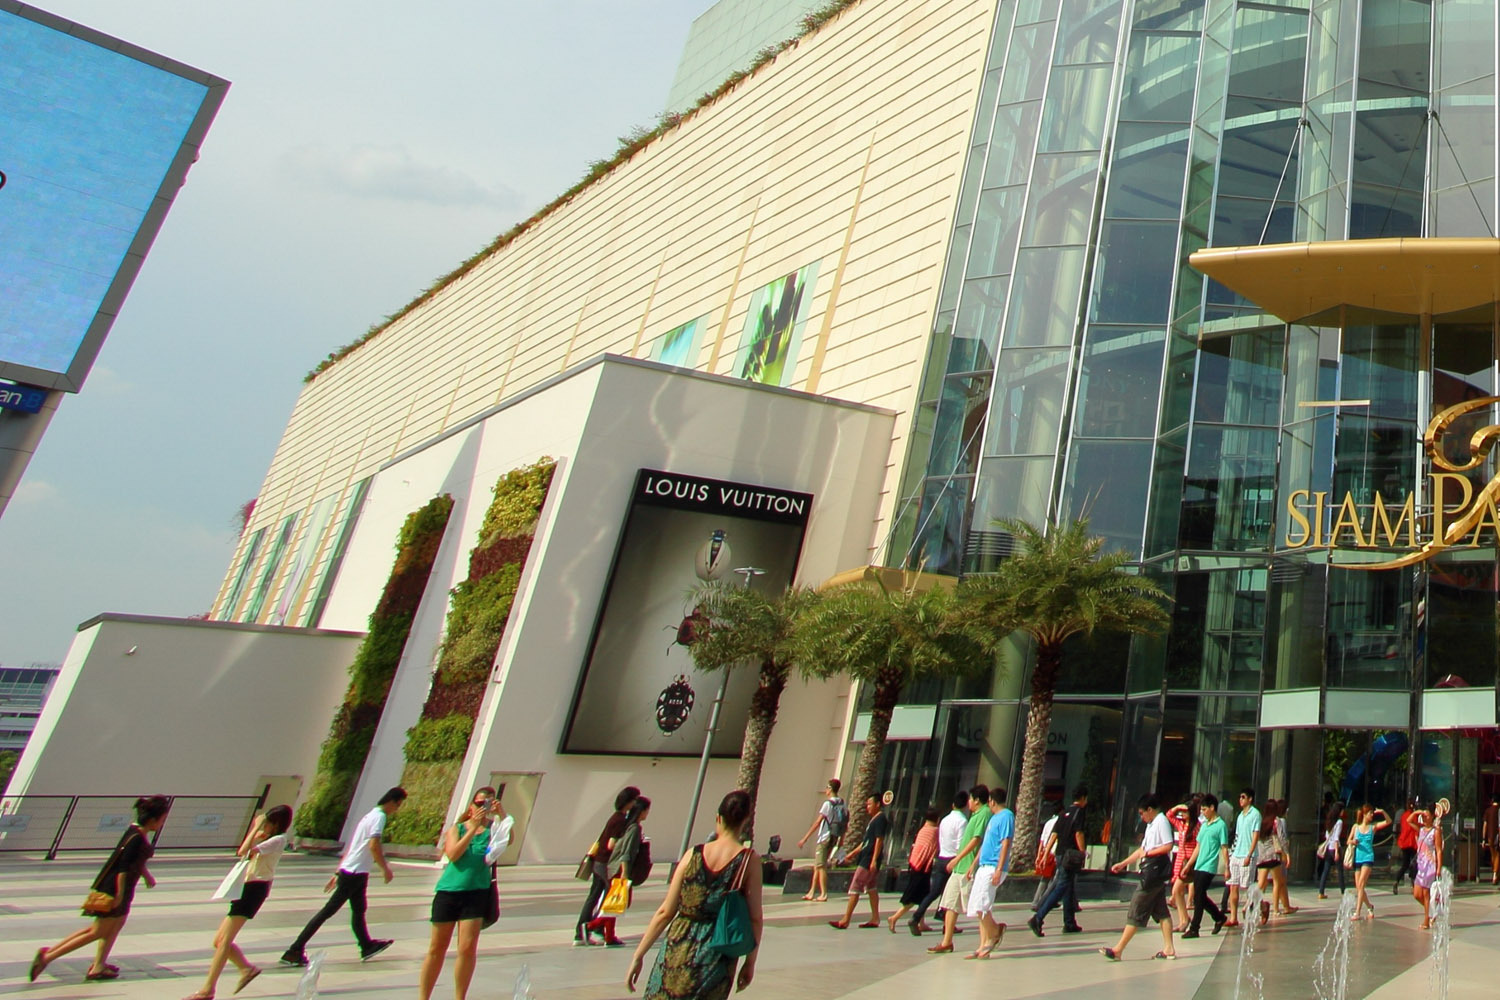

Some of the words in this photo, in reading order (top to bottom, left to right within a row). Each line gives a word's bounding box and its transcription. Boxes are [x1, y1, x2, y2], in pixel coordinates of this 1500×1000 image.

[645, 476, 710, 502] LOUIS
[720, 487, 805, 515] VUITTON
[1285, 489, 1418, 549] SIAM
